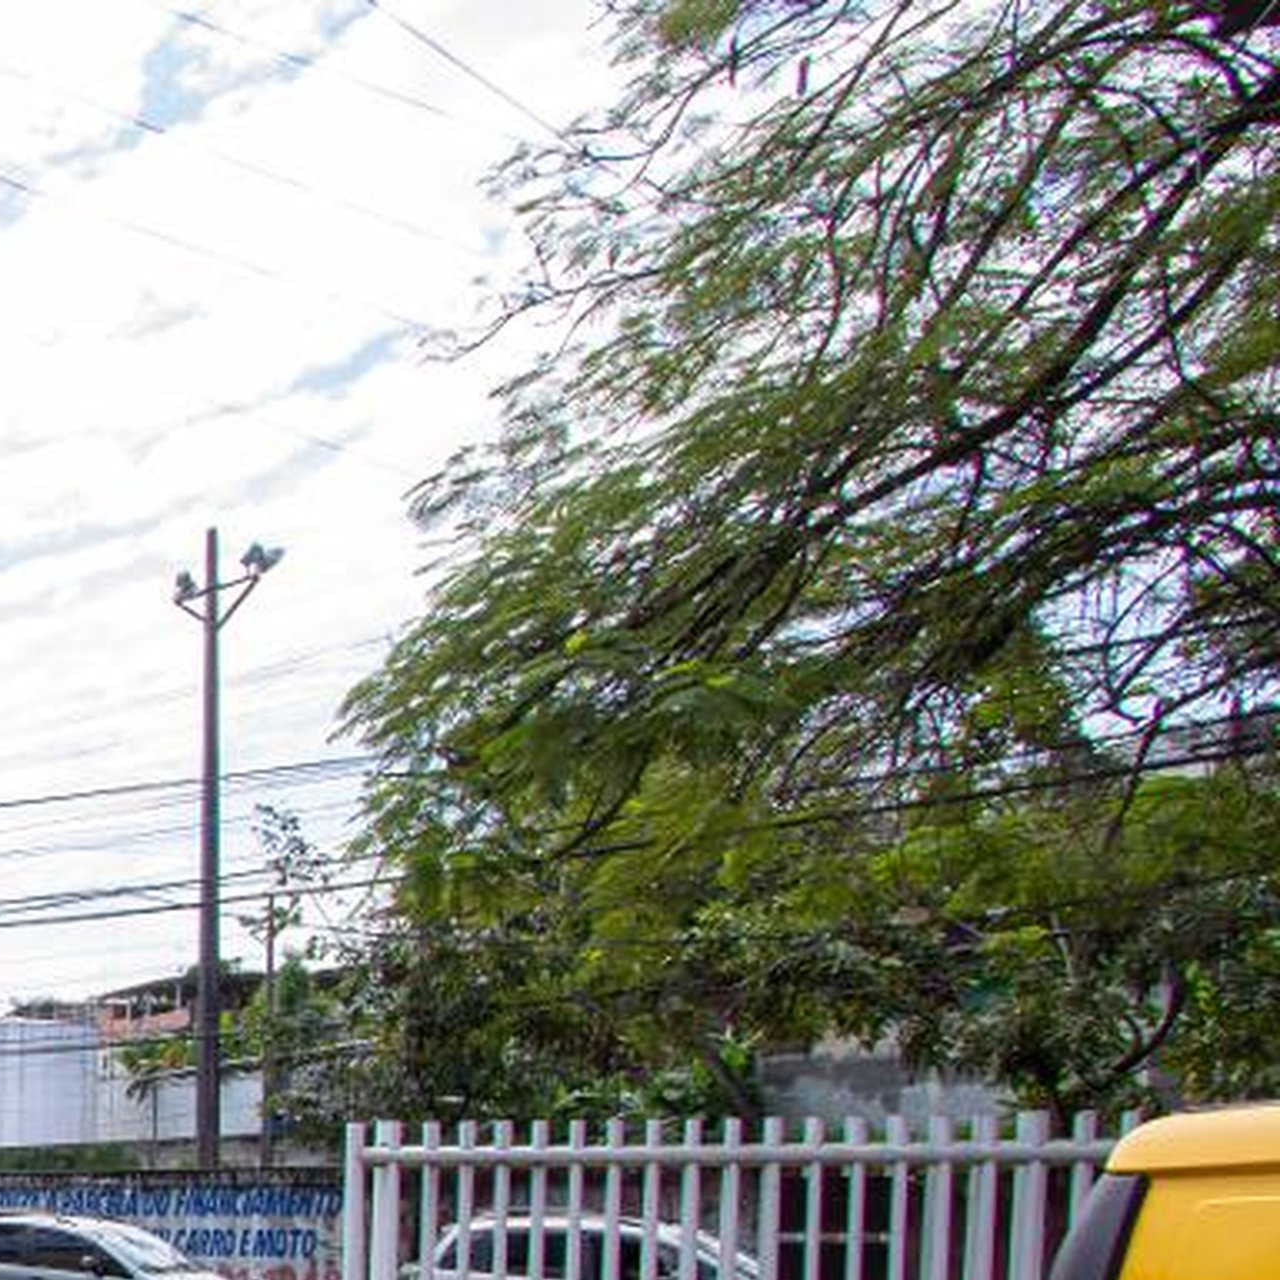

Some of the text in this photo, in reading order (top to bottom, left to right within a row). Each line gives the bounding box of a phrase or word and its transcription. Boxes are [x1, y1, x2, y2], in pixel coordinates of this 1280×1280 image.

[172, 1228, 236, 1258] CARRO
[239, 1228, 252, 1258] E
[252, 1228, 317, 1259] MOTO
